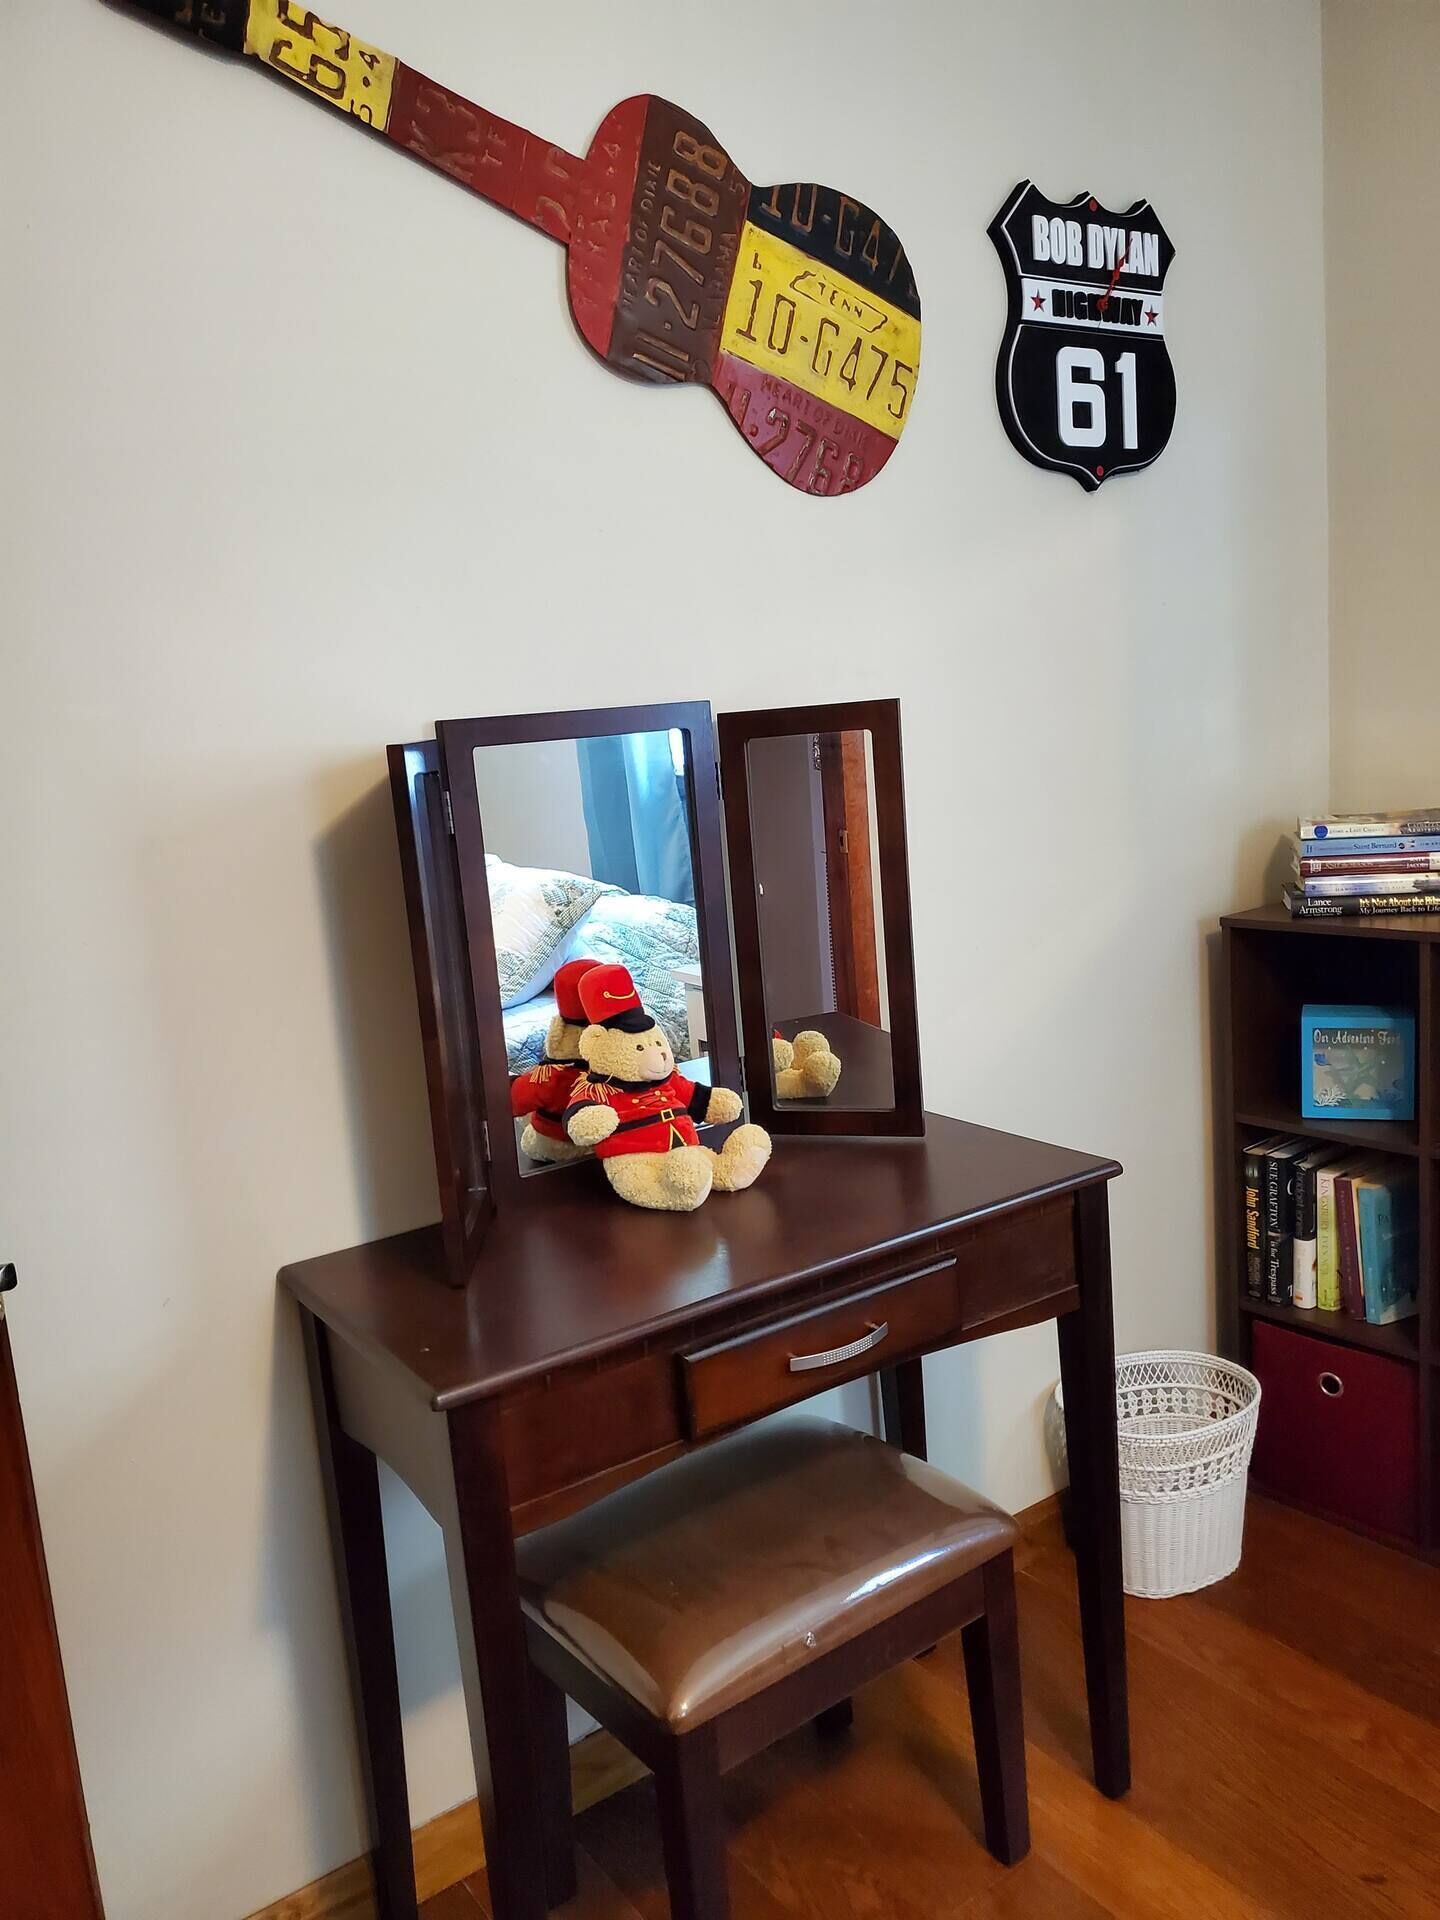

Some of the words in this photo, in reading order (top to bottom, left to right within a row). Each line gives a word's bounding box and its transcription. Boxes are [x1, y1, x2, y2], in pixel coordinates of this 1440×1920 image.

[1032, 214, 1084, 268] BOB
[1087, 222, 1160, 278] DYLAN
[817, 280, 864, 320] TENN
[1051, 288, 1144, 327] HIGHWAY
[1055, 346, 1139, 450] 61
[1353, 842, 1370, 850] Saint
[1371, 841, 1397, 850] Bernard
[1299, 905, 1343, 915] Armstrong
[1307, 897, 1332, 907] Lance
[1371, 897, 1388, 907] Not
[1389, 896, 1411, 907] About
[1412, 896, 1424, 906] the
[1372, 906, 1398, 914] Journey
[1268, 1161, 1279, 1180] SUE
[1246, 1186, 1259, 1206] John
[1268, 1181, 1279, 1229] GRAFTON
[1246, 1206, 1260, 1249] Sandford
[1267, 1258, 1281, 1295] Trespass
